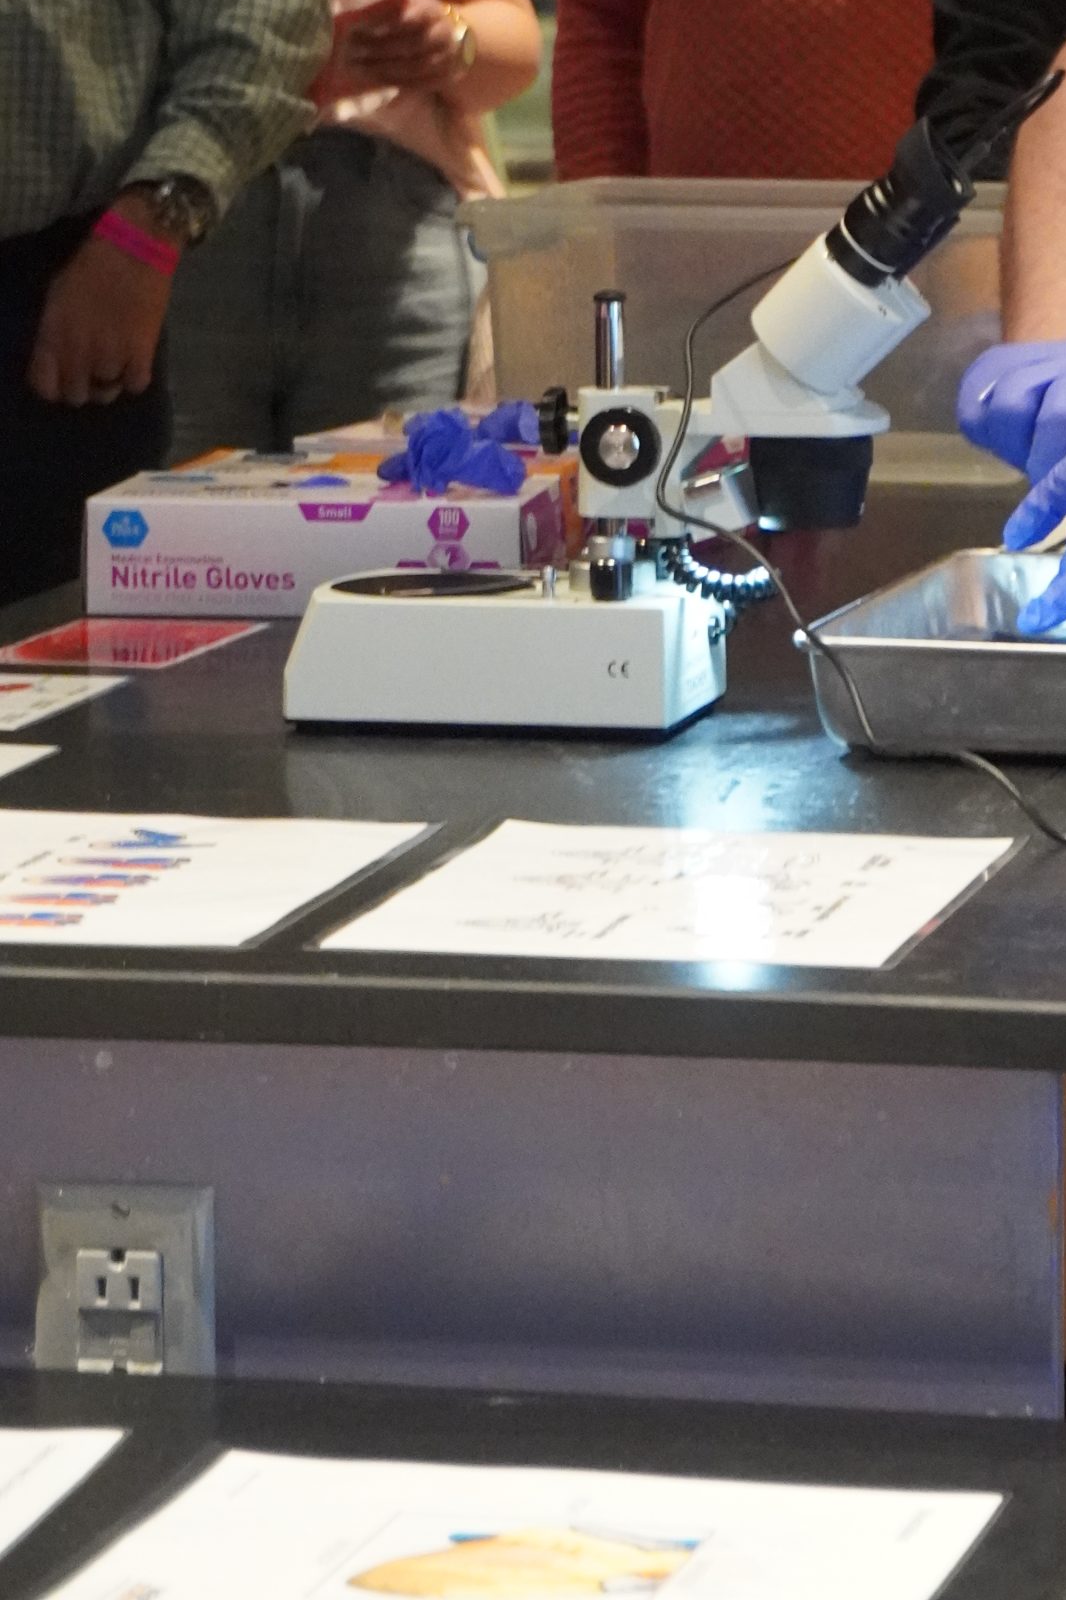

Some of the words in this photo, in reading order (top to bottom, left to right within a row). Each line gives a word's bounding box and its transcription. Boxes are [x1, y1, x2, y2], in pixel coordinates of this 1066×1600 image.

[318, 505, 353, 520] Small
[438, 508, 460, 527] 100
[111, 565, 197, 590] Nitrile
[206, 565, 296, 591] Gloves
